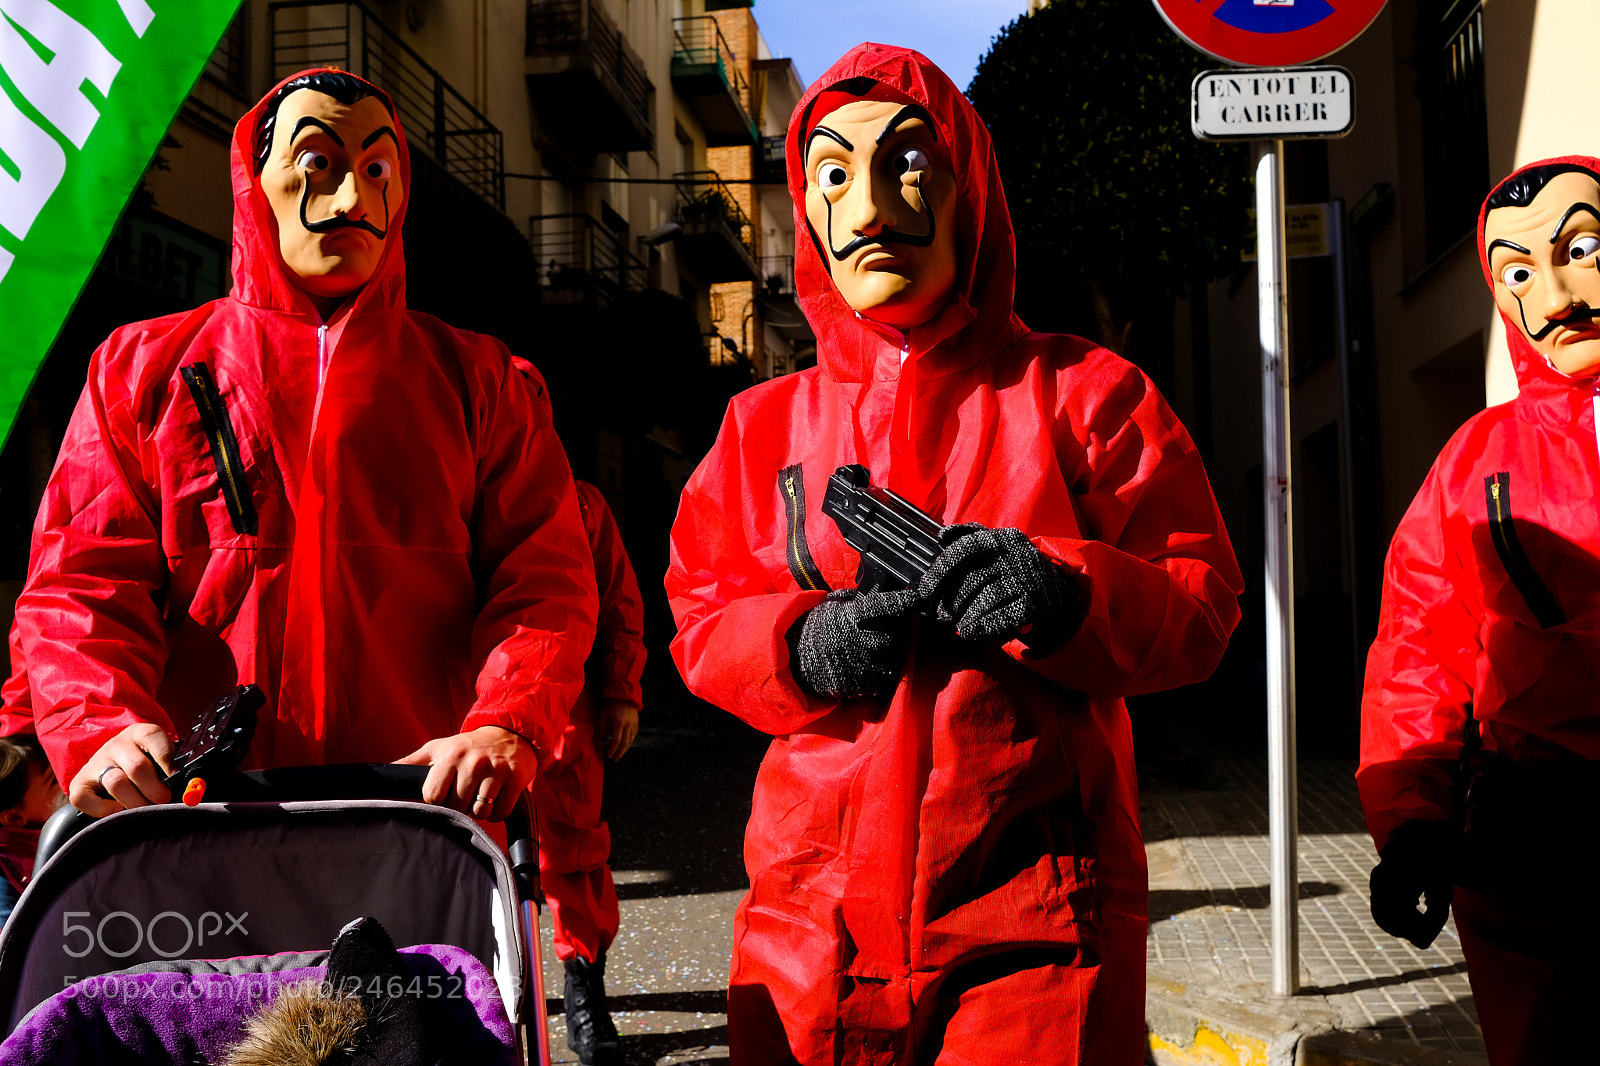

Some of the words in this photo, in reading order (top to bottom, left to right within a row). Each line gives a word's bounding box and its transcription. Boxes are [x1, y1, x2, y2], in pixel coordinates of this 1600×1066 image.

[1209, 78, 1241, 97] EN
[1248, 77, 1300, 96] TOT
[1311, 76, 1345, 94] EL
[1221, 103, 1327, 123] CARRER
